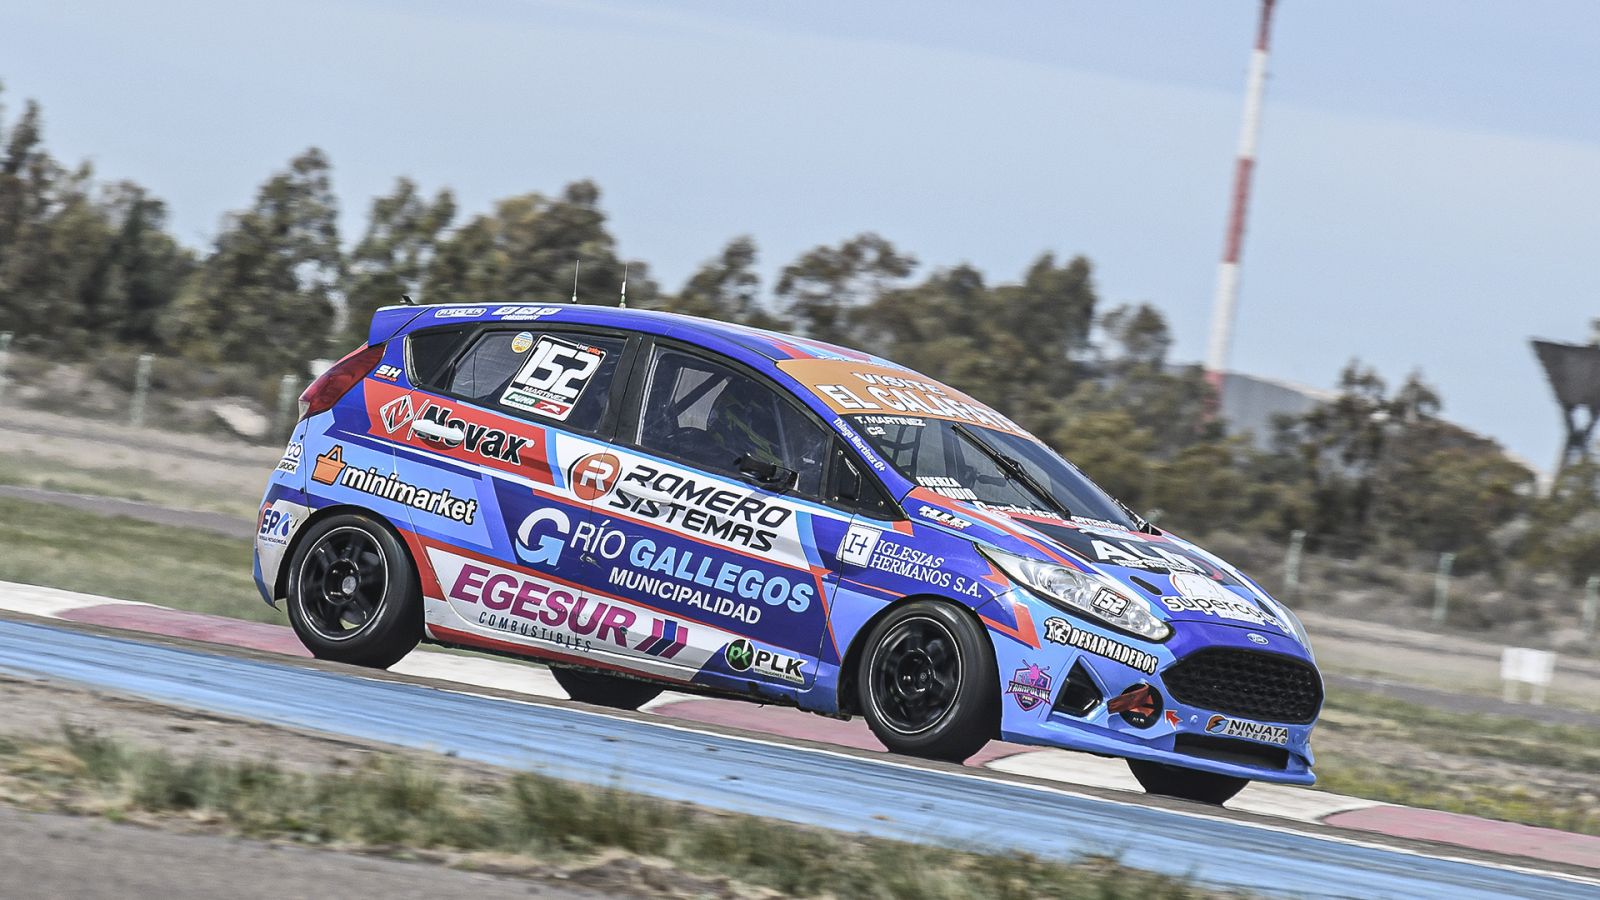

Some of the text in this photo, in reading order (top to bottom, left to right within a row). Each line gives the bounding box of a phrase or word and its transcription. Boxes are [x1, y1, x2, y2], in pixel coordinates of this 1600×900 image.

[514, 340, 601, 399] 152
[851, 372, 948, 396] VISITE
[815, 384, 883, 410] EL
[833, 417, 854, 439] Thiago
[341, 466, 476, 524] minimarket
[623, 464, 793, 529] ROMERO
[916, 476, 962, 488] FUERZA
[608, 488, 778, 552] SISTEMAS
[569, 519, 814, 613] RÍO GALLEGOS
[874, 540, 945, 568] IGLESIAS
[608, 566, 763, 625] MUNICIPALIDAD
[869, 554, 984, 599] HERMANOS S.A.
[449, 563, 637, 648] EGESUR
[1093, 589, 1128, 615] 152
[478, 611, 592, 654] COMBUSTIBLES
[1070, 628, 1158, 674] DESARMADEROS
[754, 650, 805, 678] PLK
[1227, 729, 1288, 745] BATERIAS
[1229, 720, 1288, 739] NINJATA
